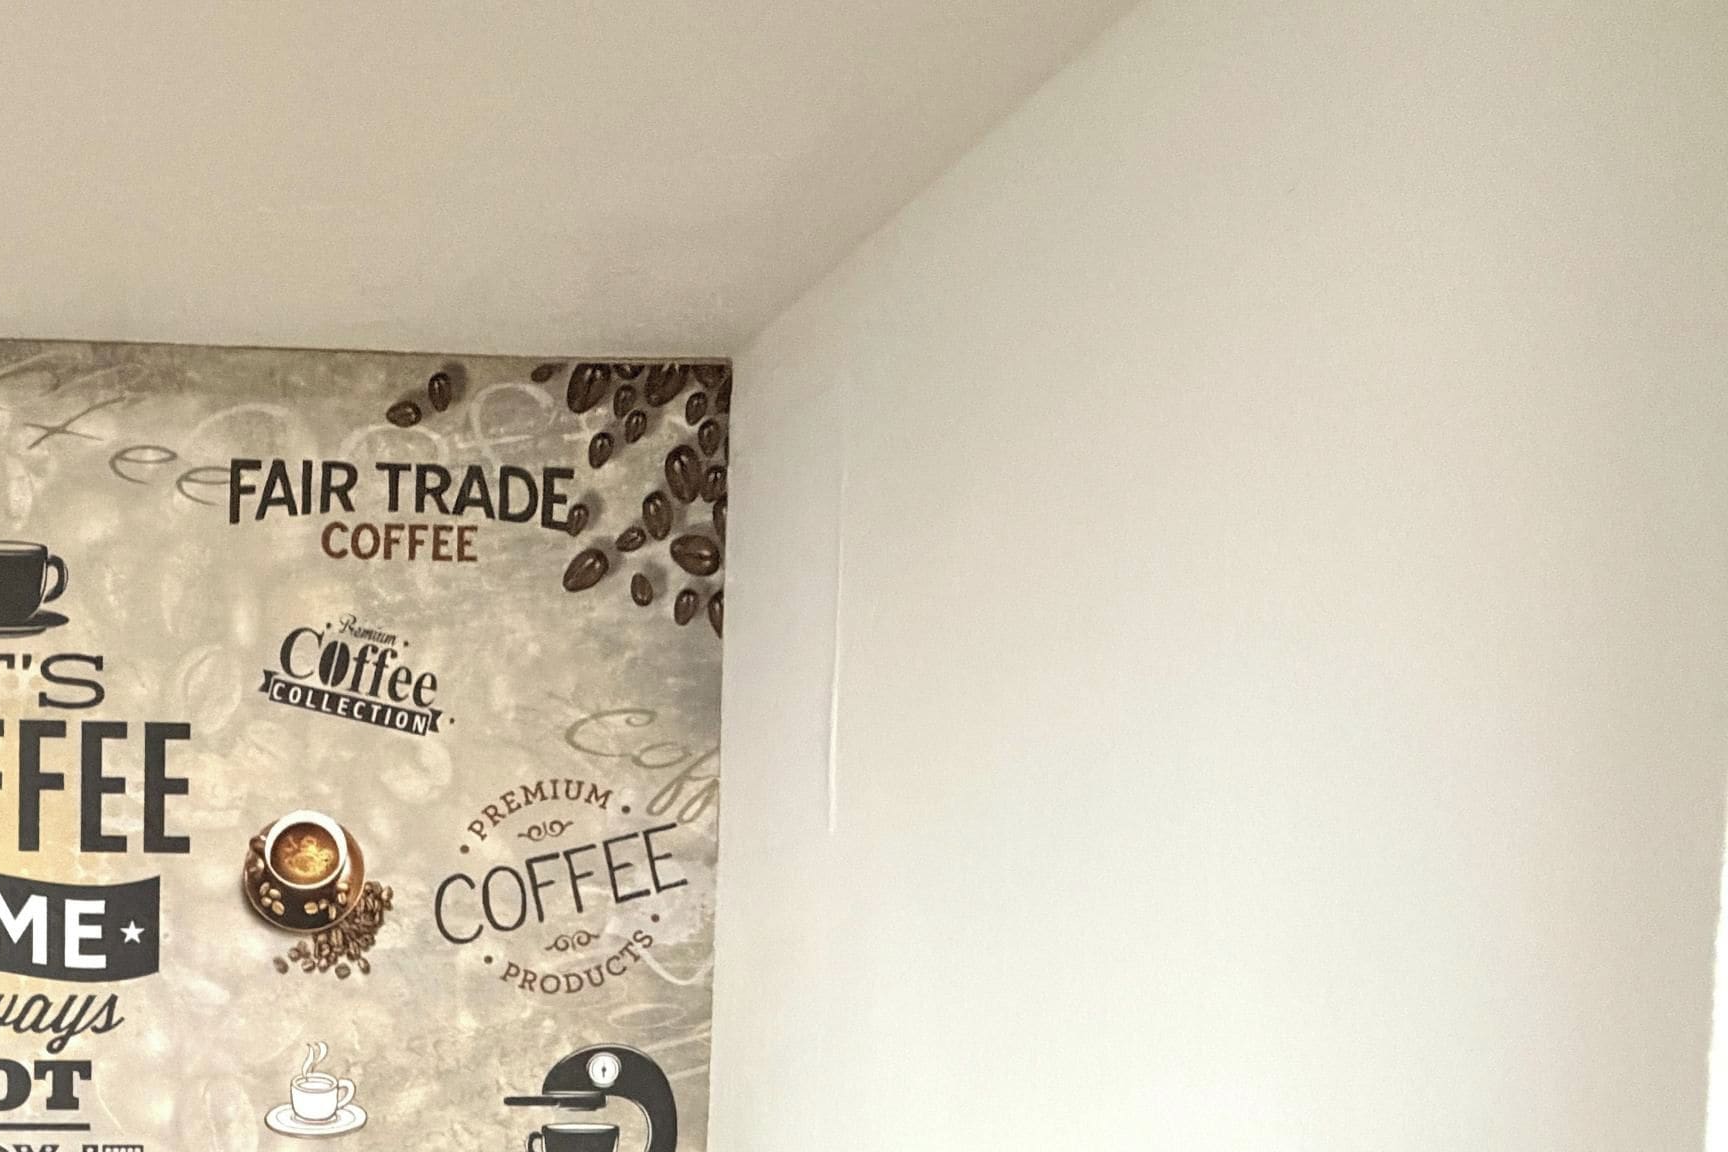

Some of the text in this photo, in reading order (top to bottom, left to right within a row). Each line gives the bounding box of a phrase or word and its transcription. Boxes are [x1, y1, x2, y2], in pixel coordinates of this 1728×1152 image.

[229, 458, 576, 533] FAIR TRADE
[320, 521, 479, 563] COFFEE
[280, 627, 438, 708] Coffee
[272, 682, 427, 735] COLLECTION
[468, 777, 614, 841] PREMIUM
[433, 823, 689, 945] COFFEE
[500, 929, 655, 996] PRODUCTS
